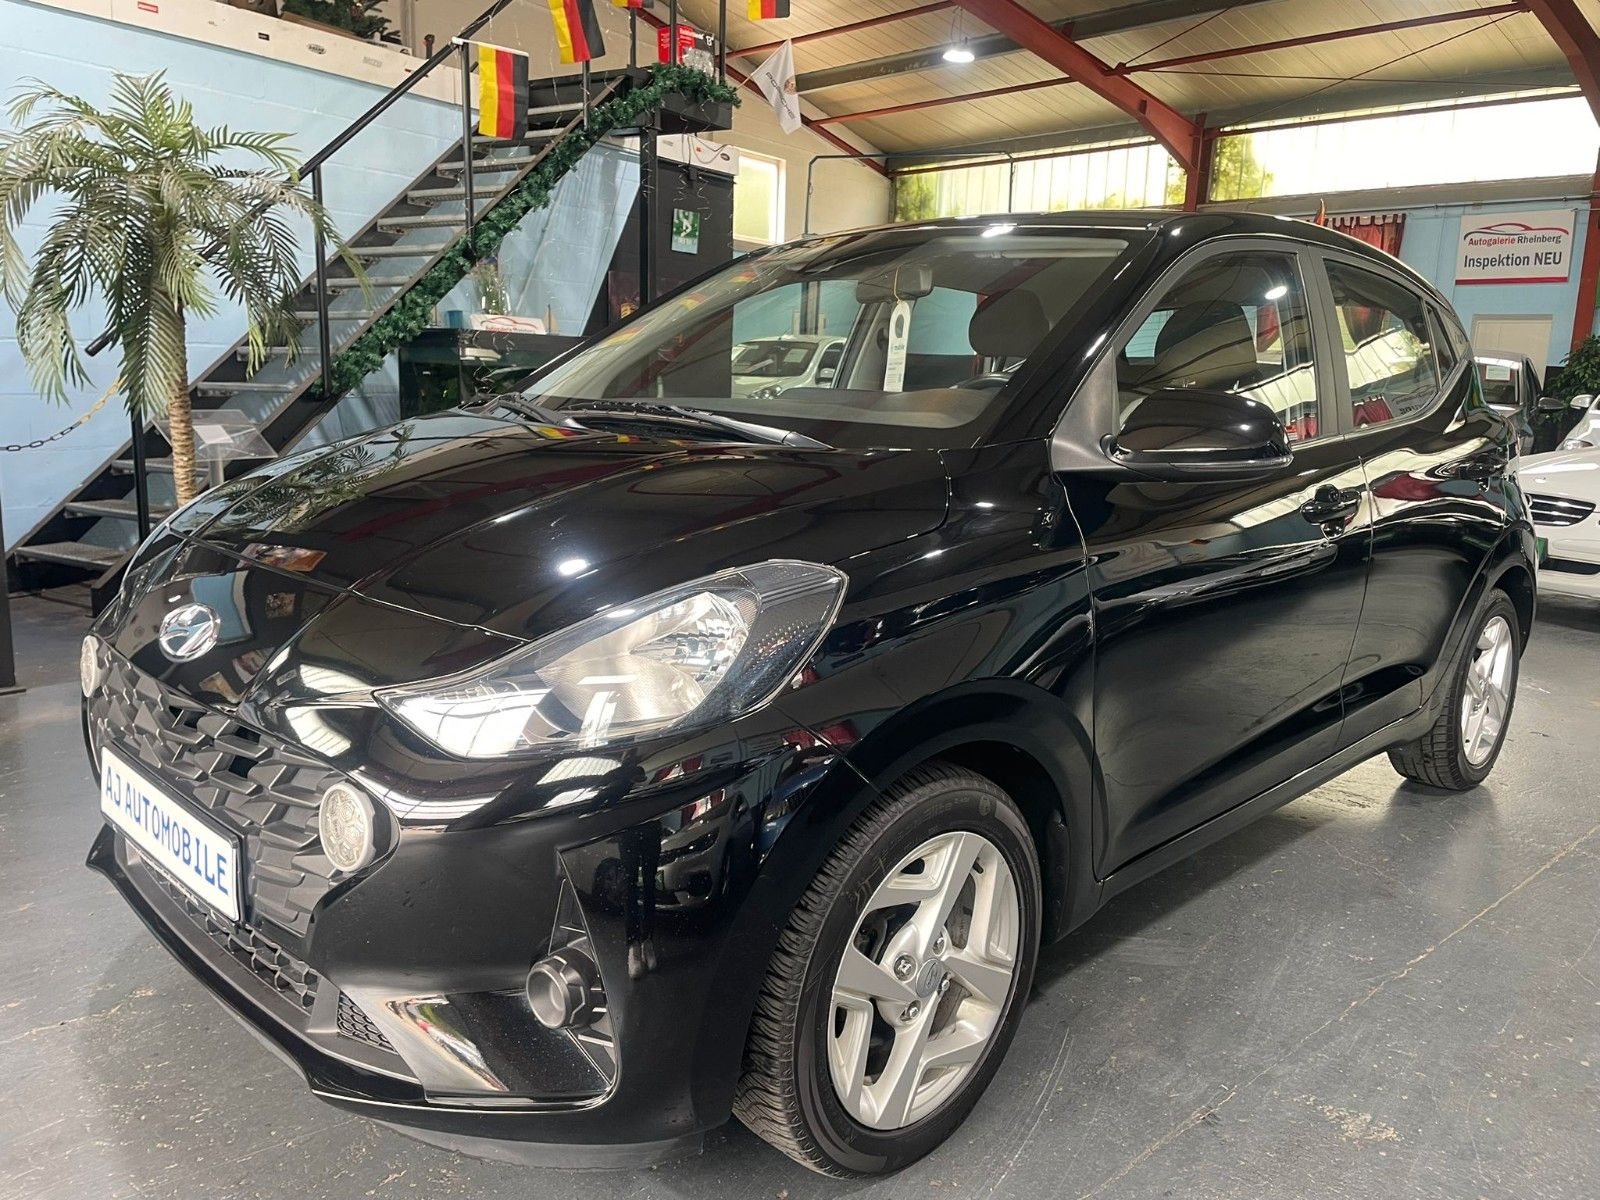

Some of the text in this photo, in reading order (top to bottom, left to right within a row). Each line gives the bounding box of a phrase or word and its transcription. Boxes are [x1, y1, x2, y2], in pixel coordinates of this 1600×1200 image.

[1468, 234, 1562, 247] Autogalerie Rheinberg
[1464, 252, 1562, 269] Inspektion NEU
[106, 766, 121, 807] AJ
[125, 782, 229, 896] AUTOMOBILE
